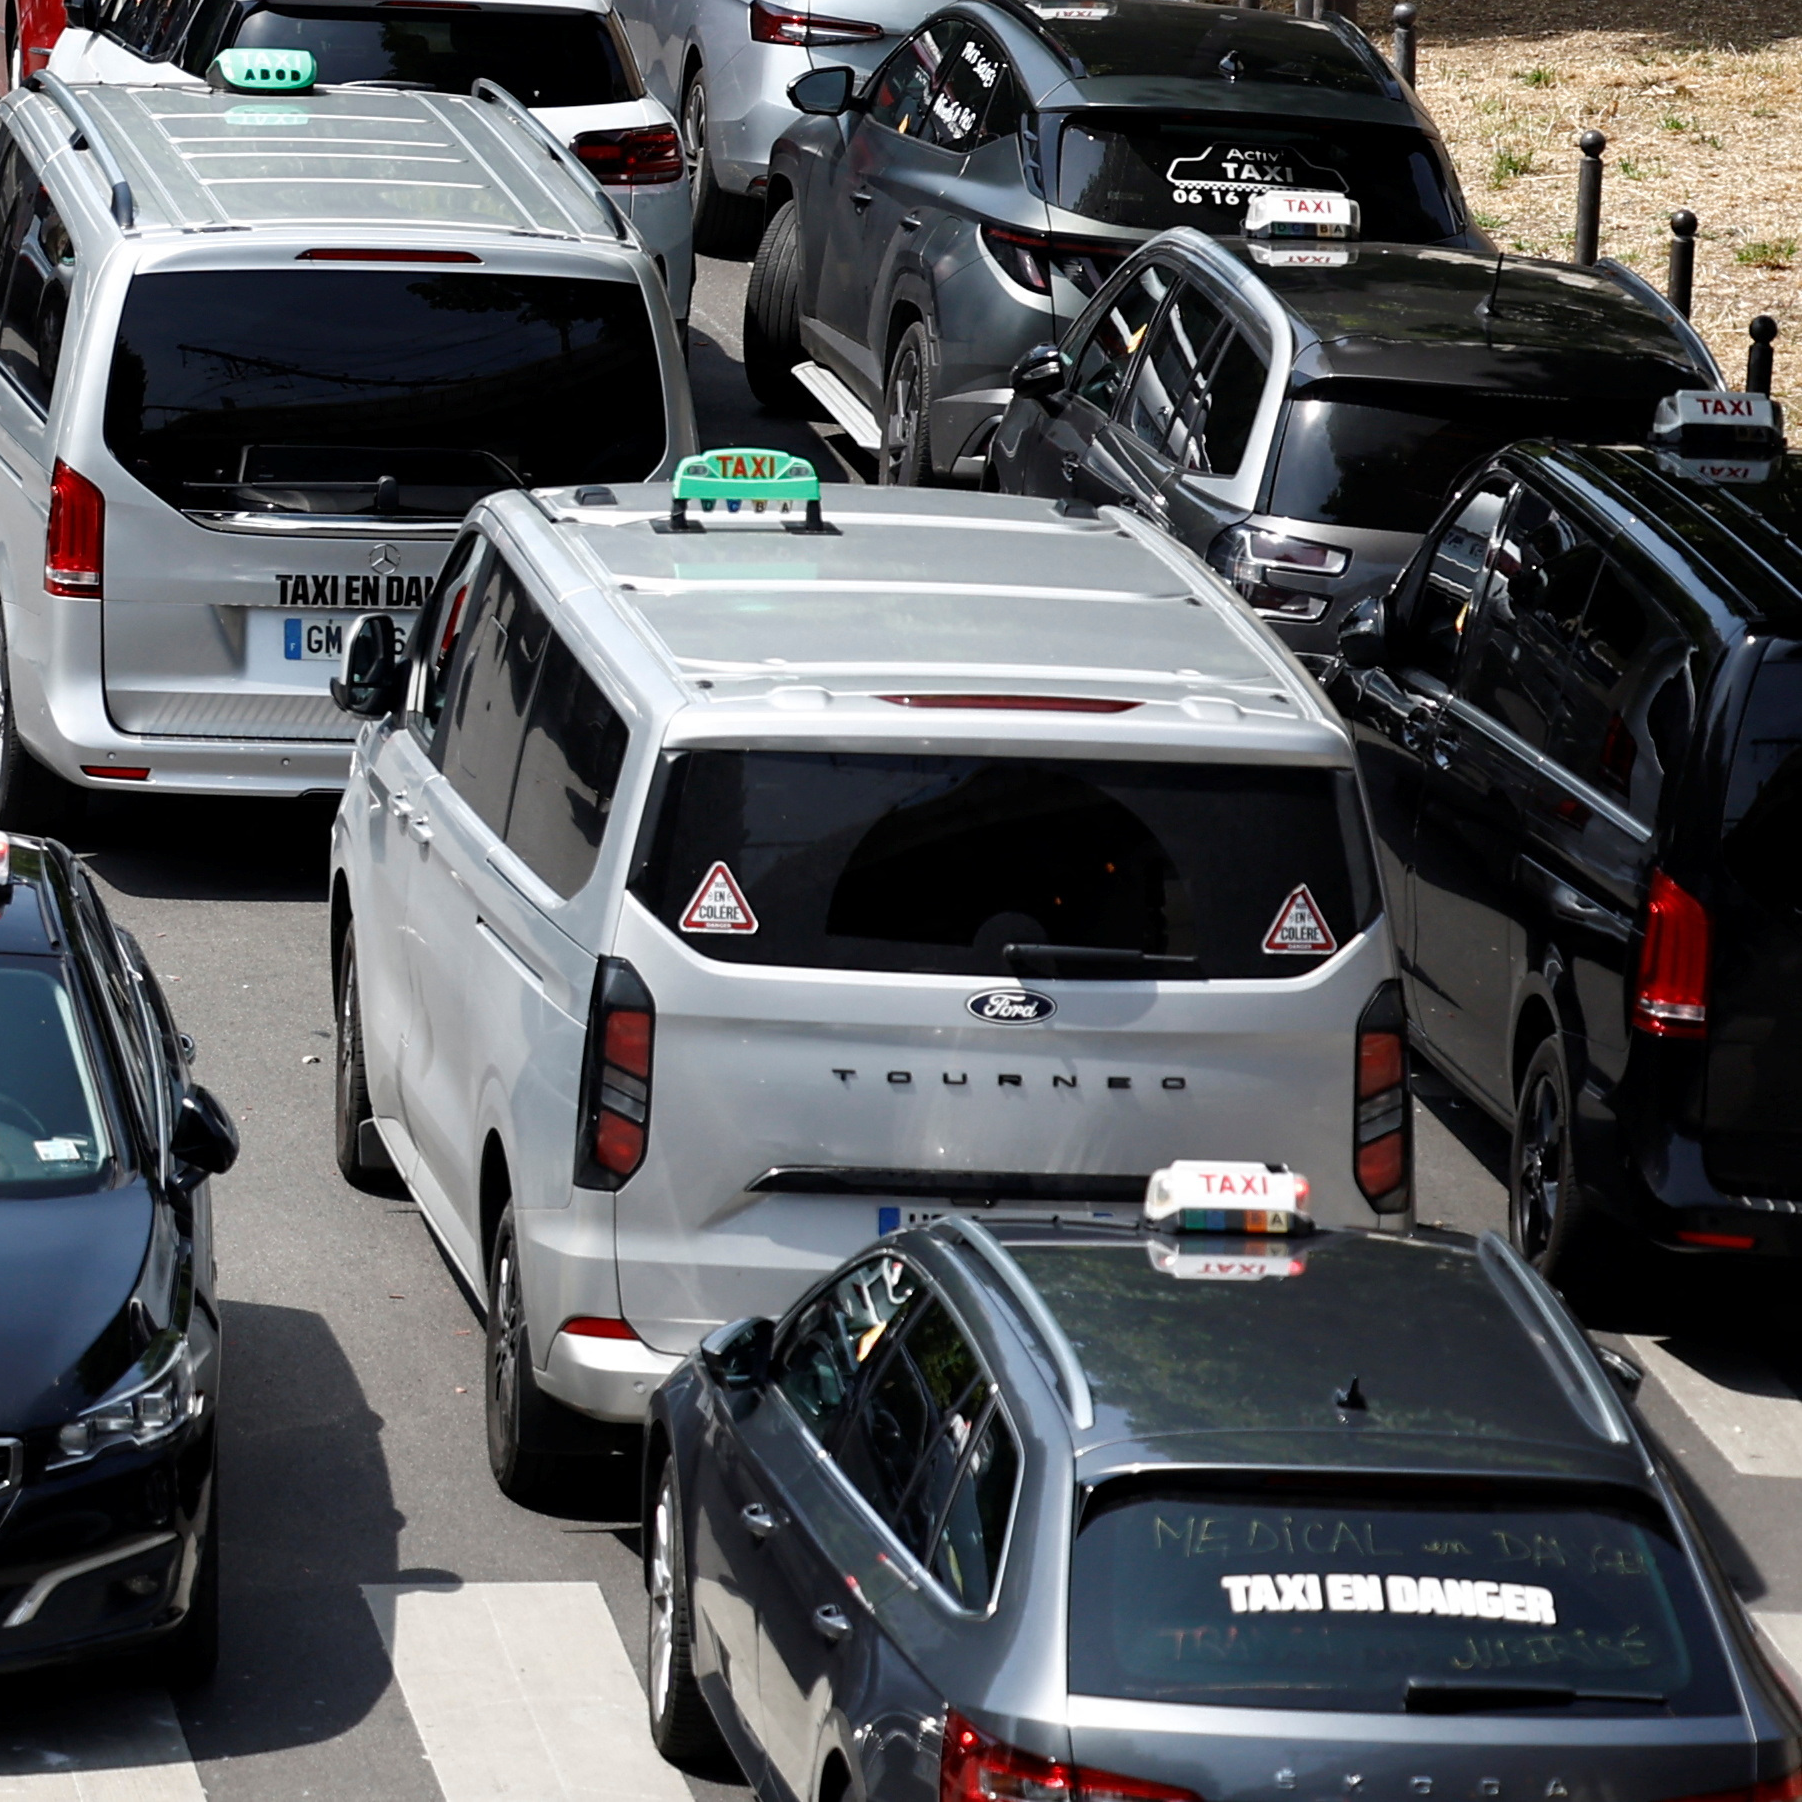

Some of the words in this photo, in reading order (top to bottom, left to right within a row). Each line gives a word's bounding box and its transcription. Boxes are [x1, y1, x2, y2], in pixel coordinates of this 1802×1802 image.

[243, 51, 301, 66] TAXI
[1221, 162, 1294, 183] TAXI
[1173, 190, 1202, 205] 06
[1212, 191, 1240, 207] 16
[1283, 199, 1333, 215] TAXI
[1696, 398, 1753, 417] TAXI
[716, 455, 775, 479] TAXI
[276, 575, 340, 608] TAXI
[344, 575, 379, 608] EN
[714, 891, 725, 902] EN
[1296, 912, 1306, 922] EN
[982, 993, 1038, 1018] Ford
[831, 1068, 1186, 1091] TOURNEO
[1199, 1174, 1269, 1196] TAXI
[1221, 1574, 1323, 1613] TAXI
[1324, 1574, 1384, 1613] EN
[1385, 1575, 1556, 1625] DANGER
